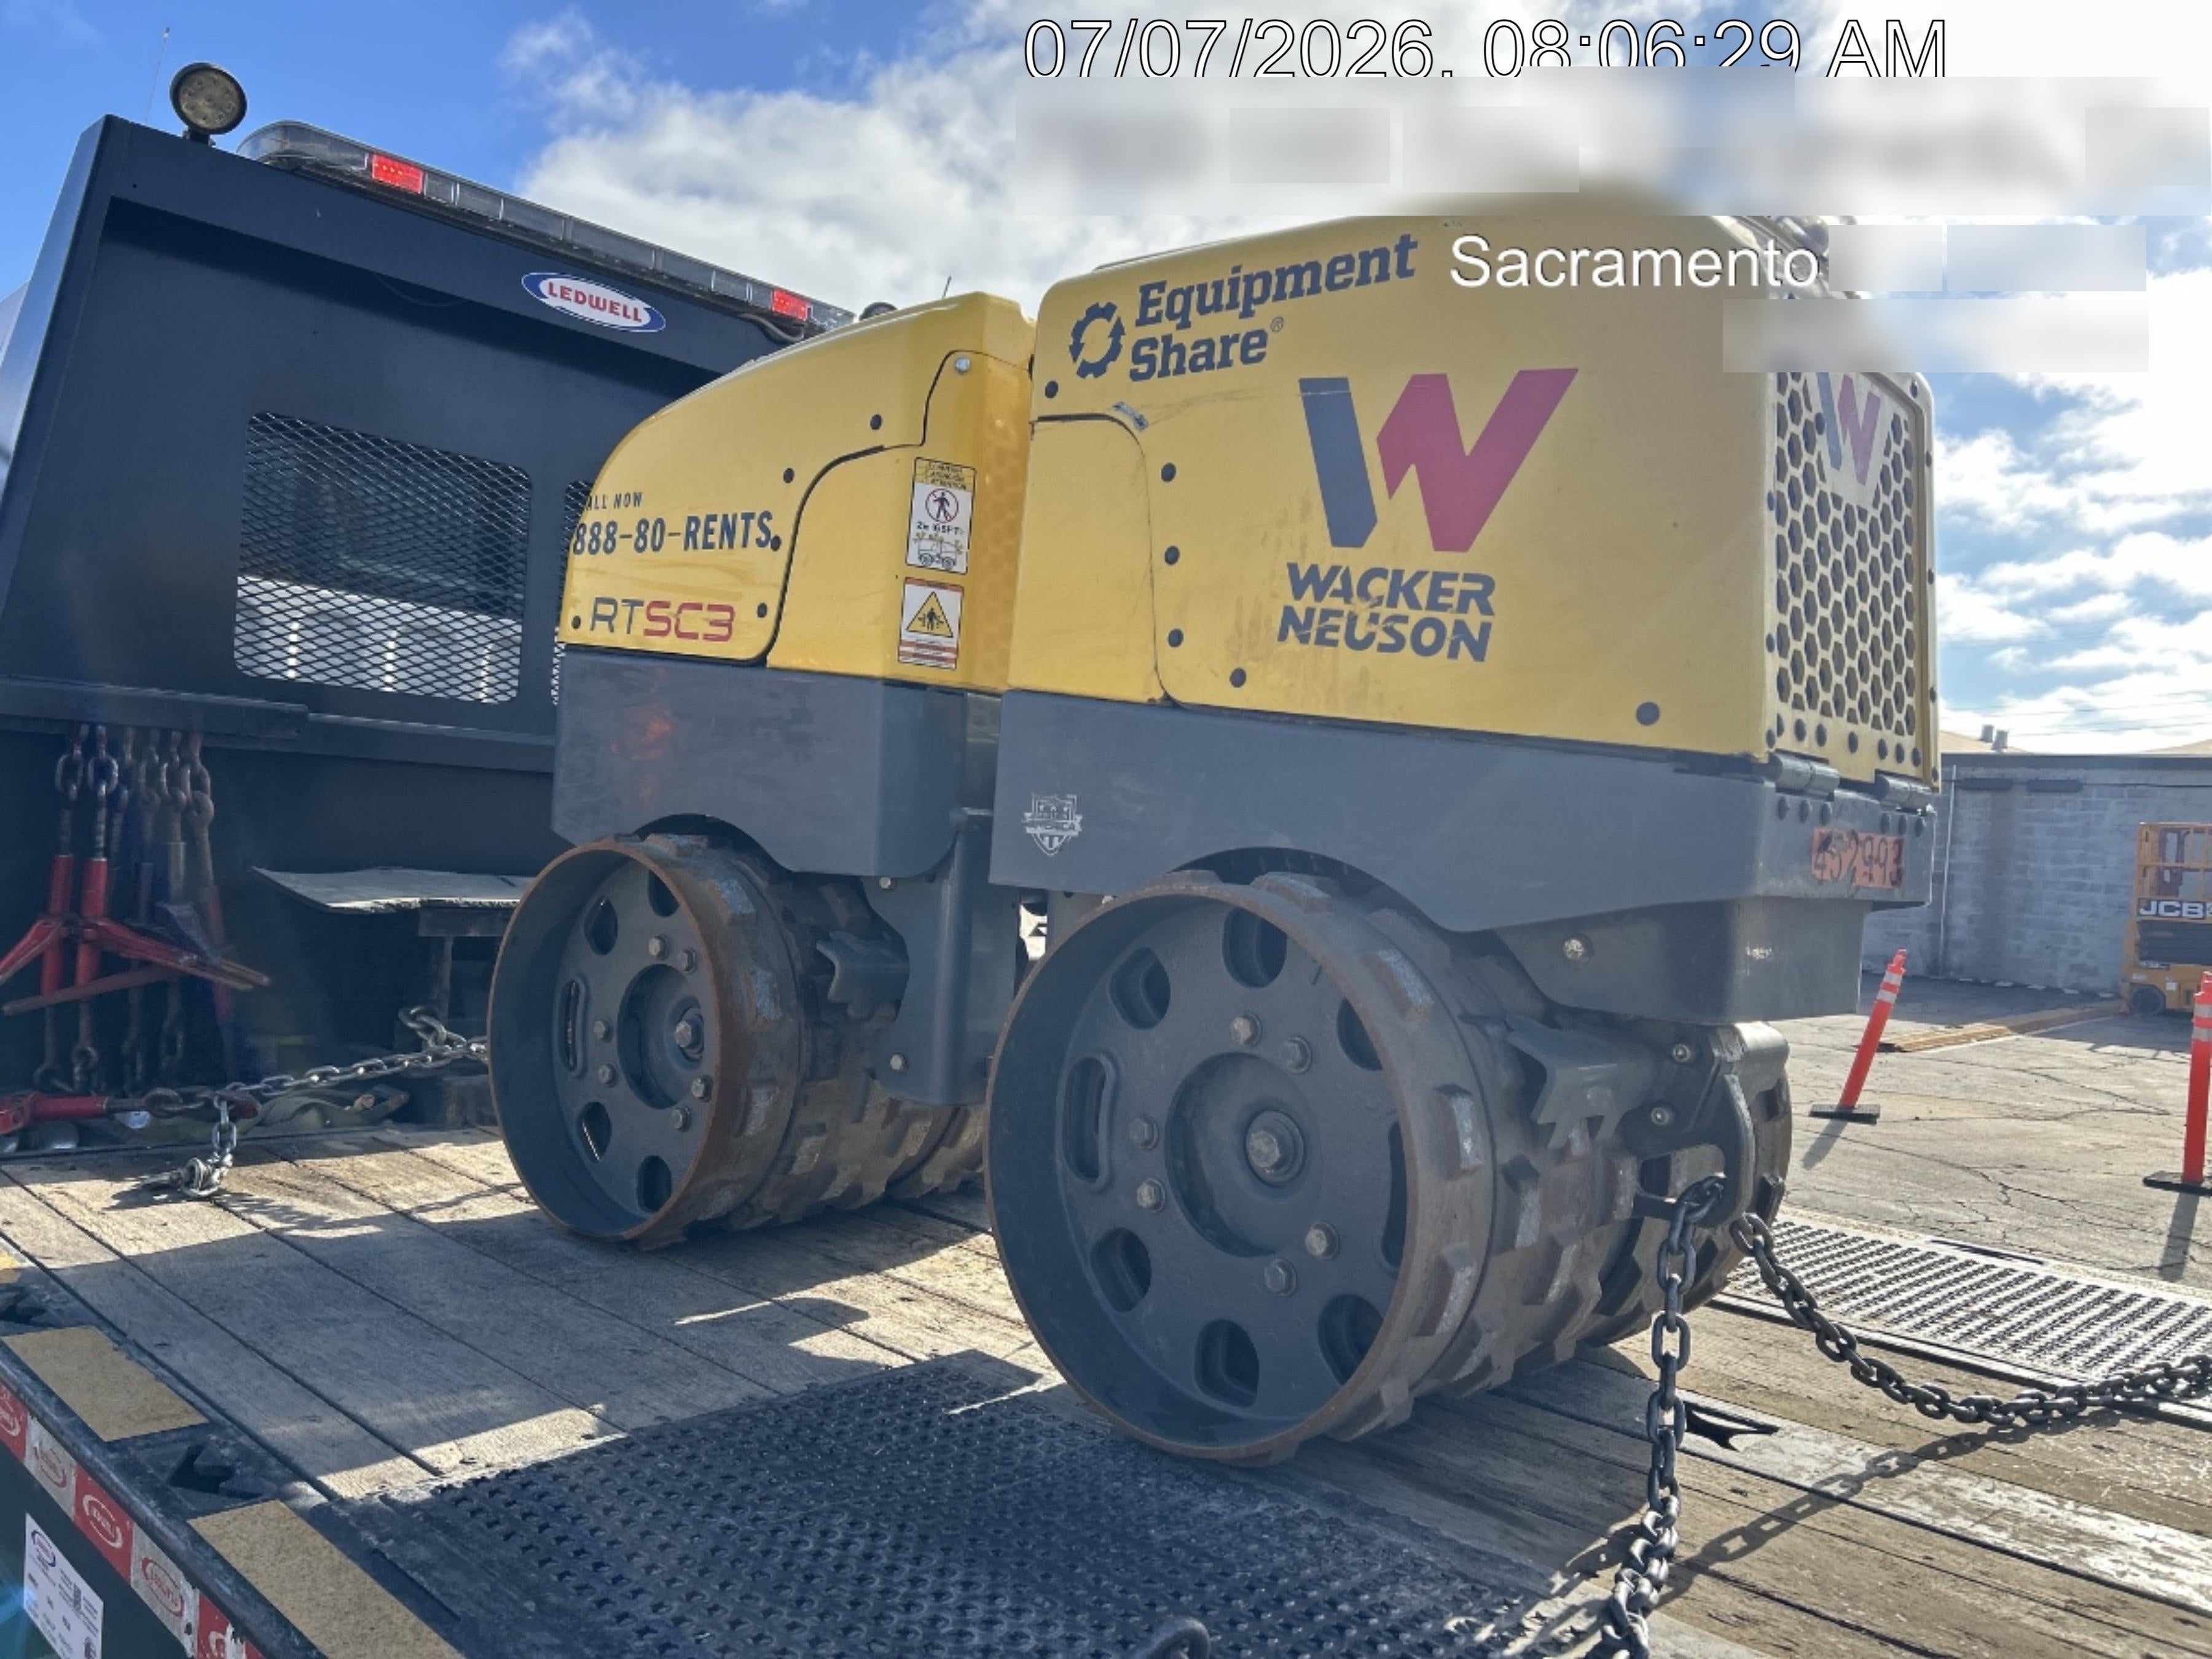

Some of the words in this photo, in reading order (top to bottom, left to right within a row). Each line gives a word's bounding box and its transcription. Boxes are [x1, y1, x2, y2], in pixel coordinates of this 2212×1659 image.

[548, 281, 641, 323] LEDWELL
[1135, 233, 1418, 330] Equipment
[584, 493, 607, 511] ALL
[614, 492, 642, 509] NOW
[1287, 561, 1496, 617] WACKER
[590, 597, 735, 641] RTSC3
[1277, 604, 1492, 662] NEUSON
[2139, 901, 2204, 919] JCB
